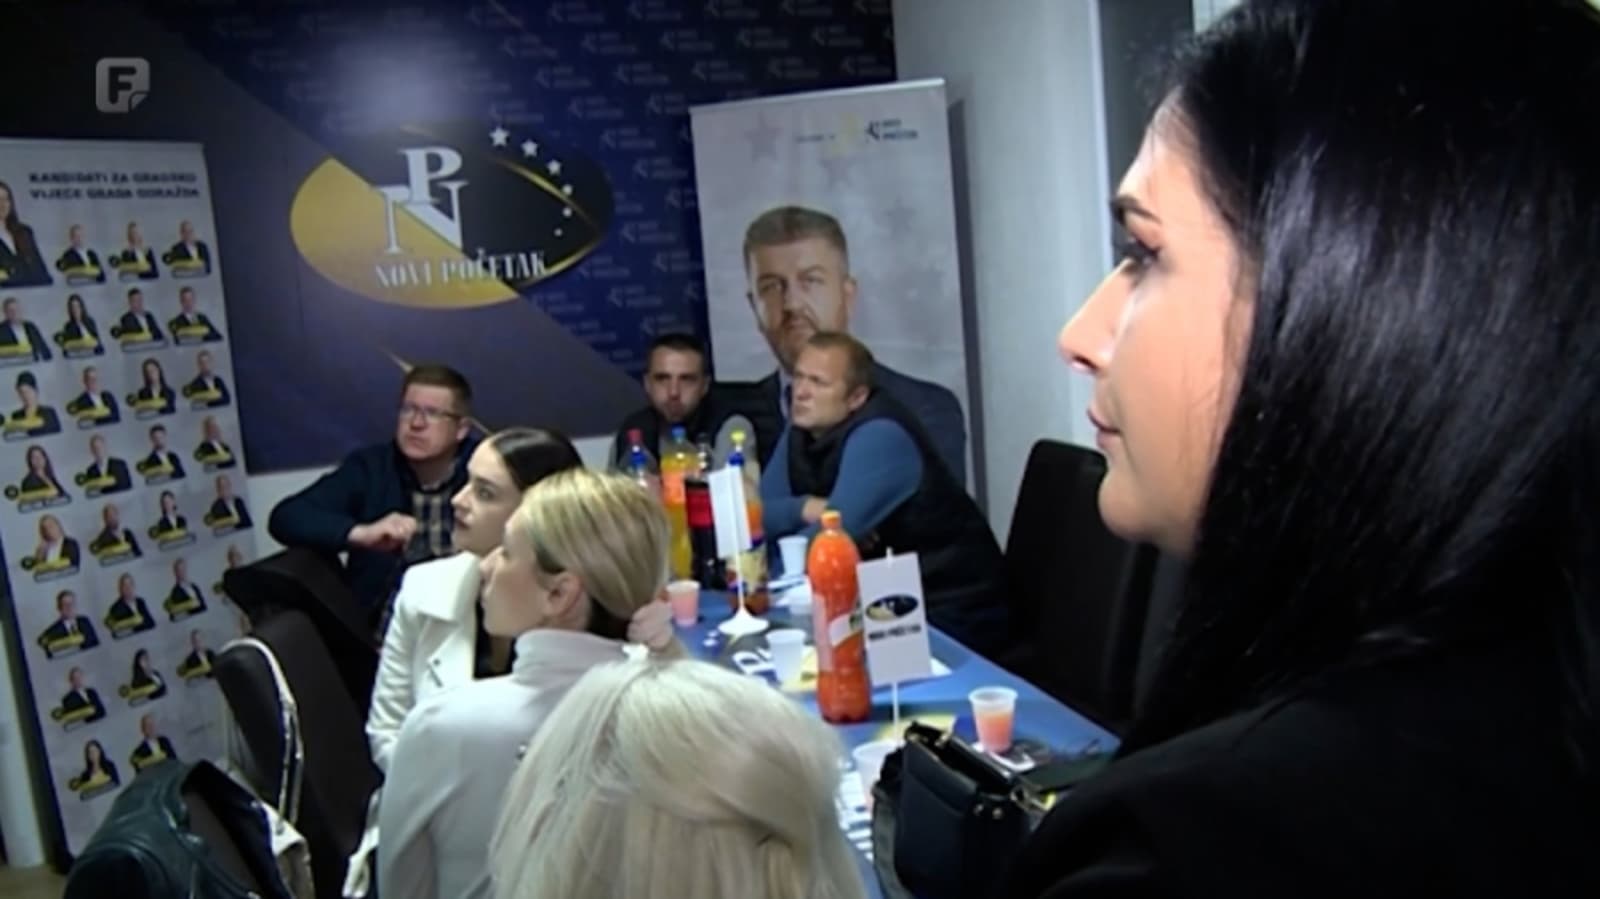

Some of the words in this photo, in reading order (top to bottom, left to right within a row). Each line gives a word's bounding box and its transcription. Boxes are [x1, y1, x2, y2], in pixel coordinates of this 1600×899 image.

[111, 172, 129, 184] ZA
[374, 260, 432, 288] NOVI
[441, 247, 547, 284] POČETAK
